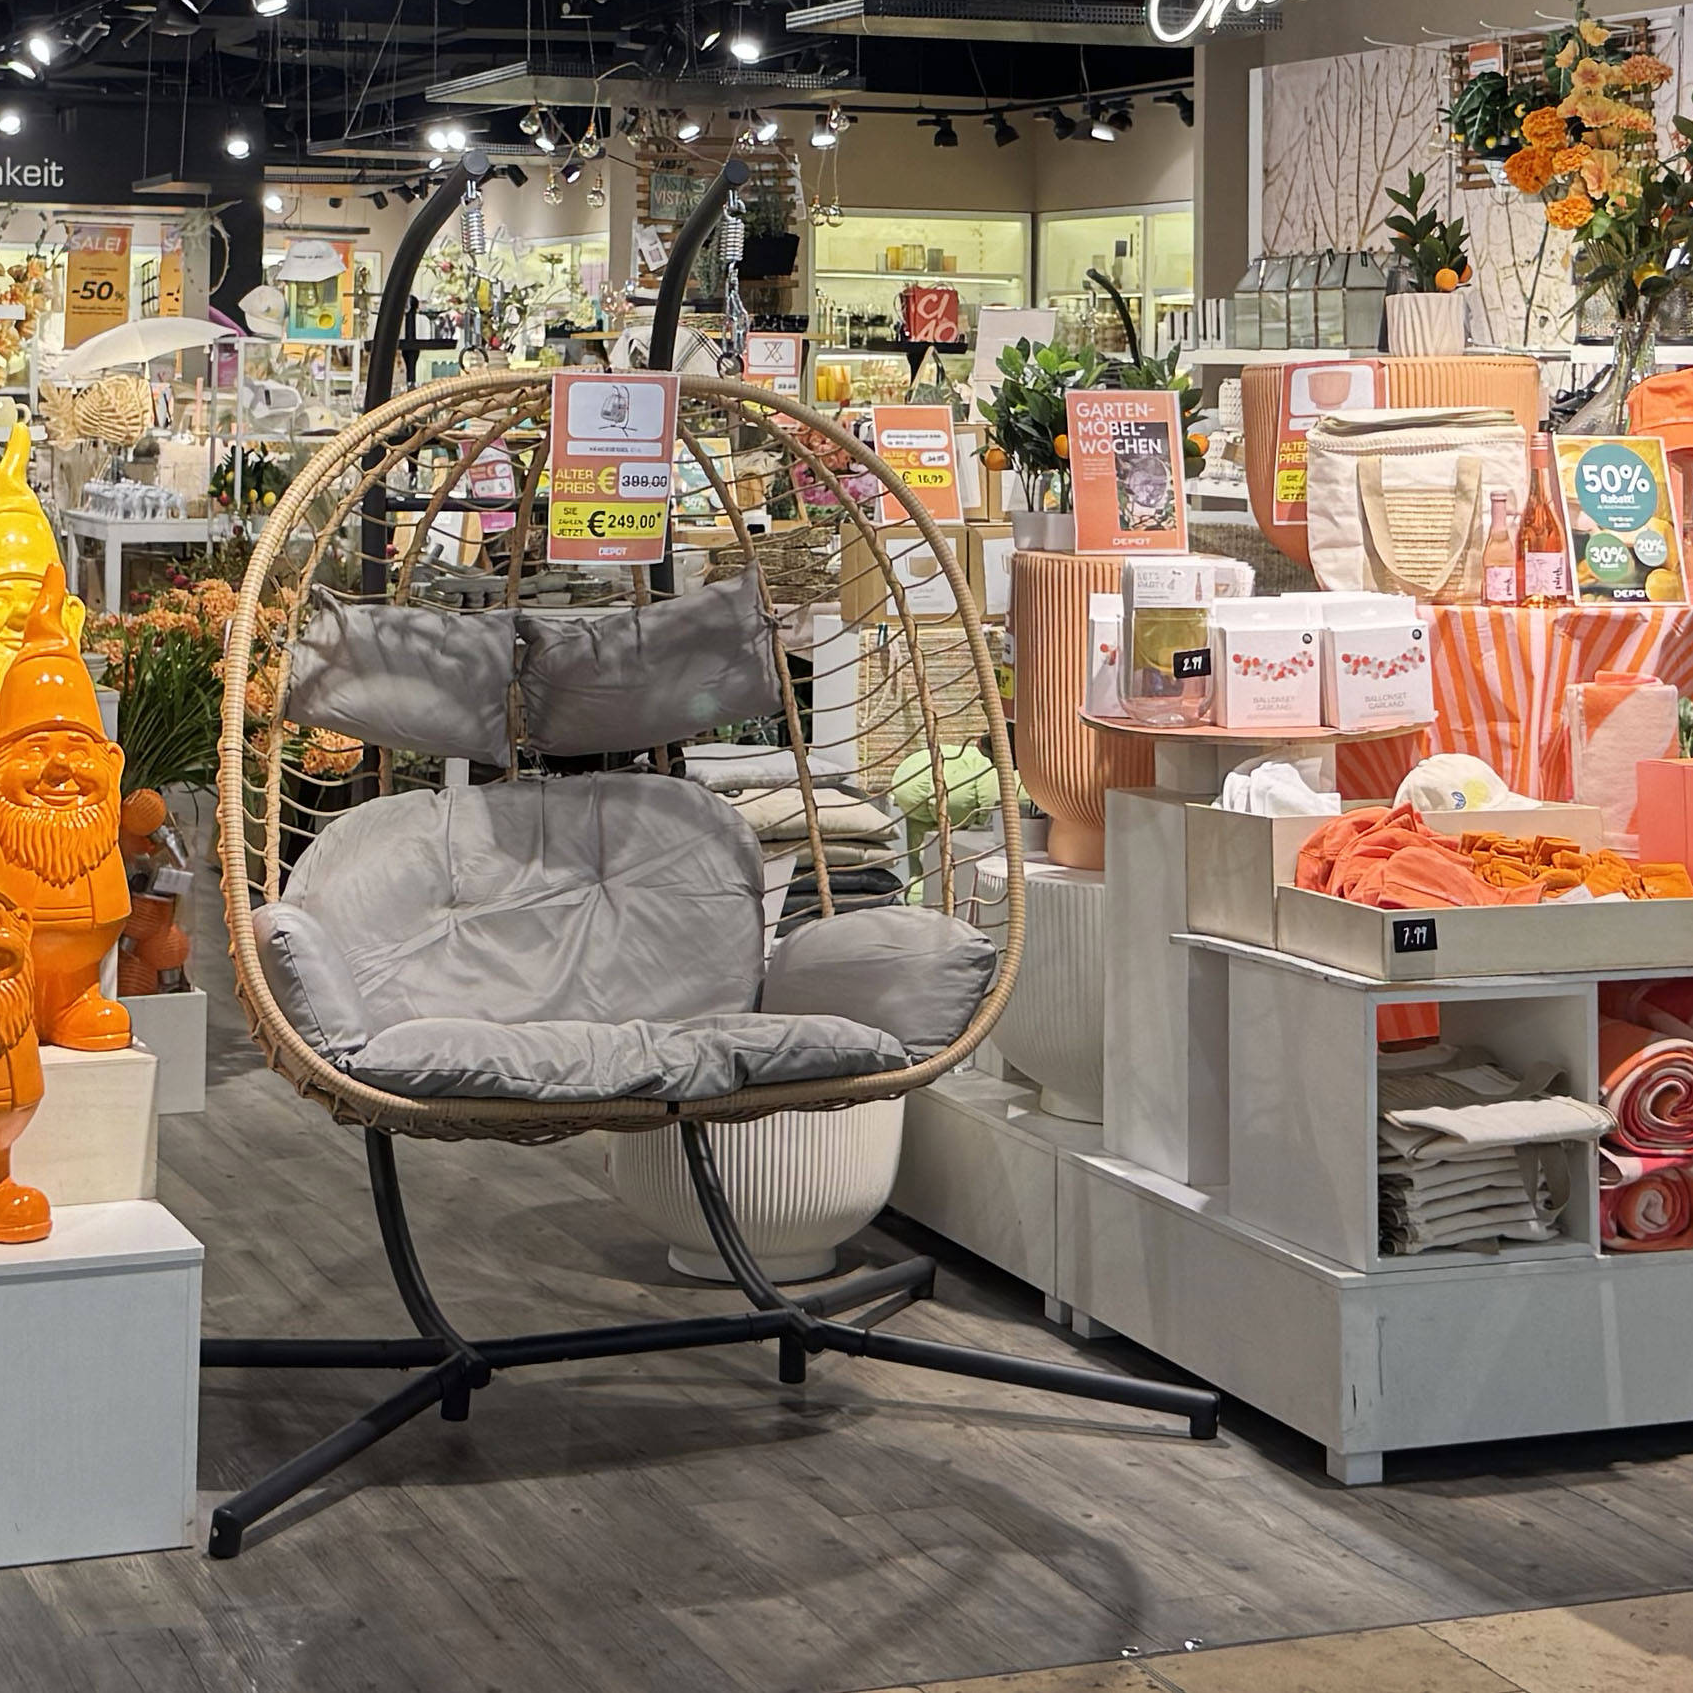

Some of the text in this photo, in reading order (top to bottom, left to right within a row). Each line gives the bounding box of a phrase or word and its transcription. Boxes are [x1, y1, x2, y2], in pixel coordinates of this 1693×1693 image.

[1076, 402, 1156, 418] GARTEN-
[1077, 418, 1146, 436] MÖBEL-
[1078, 438, 1163, 455] WOCHEN
[555, 468, 594, 480] ALTER
[1582, 464, 1651, 493] 50%
[554, 481, 596, 495] PREIS
[563, 507, 577, 515] SIE
[556, 528, 584, 537] JETZT
[1112, 537, 1151, 546] DEPOT
[1636, 538, 1666, 553] 20%
[598, 546, 627, 556] DEPOT
[1589, 546, 1628, 564] 30%
[1365, 691, 1407, 703] BALLONSET
